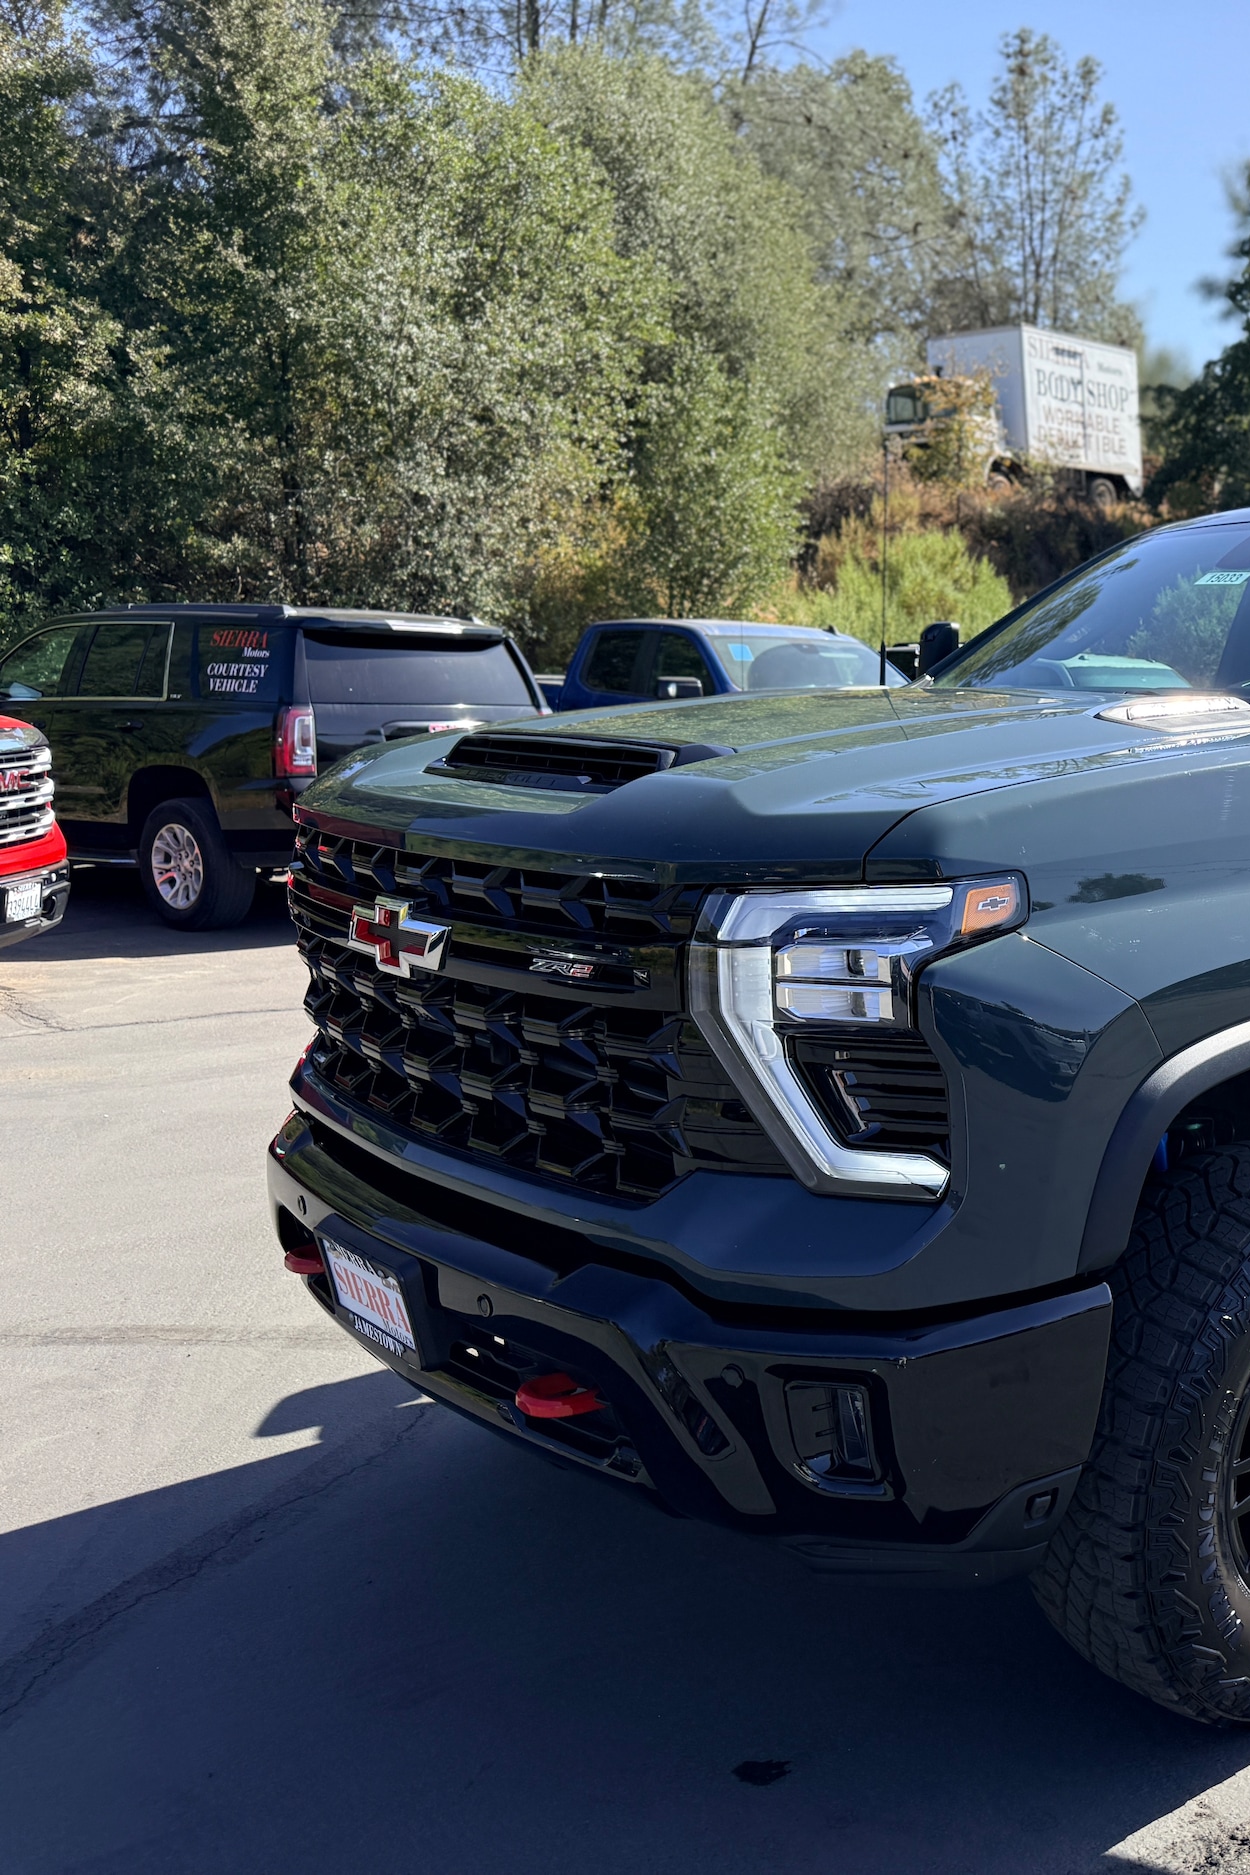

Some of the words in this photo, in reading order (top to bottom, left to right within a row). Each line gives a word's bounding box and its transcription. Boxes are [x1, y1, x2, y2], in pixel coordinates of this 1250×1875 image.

[1035, 368, 1082, 405] BODY
[1086, 379, 1129, 413] SHOP
[210, 629, 269, 648] SIERRA
[242, 647, 270, 658] Motors
[207, 662, 269, 678] COURTESY
[209, 678, 258, 693] VEHICLE
[0, 768, 31, 790] MC
[529, 957, 594, 979] ZR2
[333, 1261, 412, 1334] SIERRA
[353, 1314, 402, 1358] JAMESTOWN
[1197, 1388, 1244, 1652] WRANGLER
